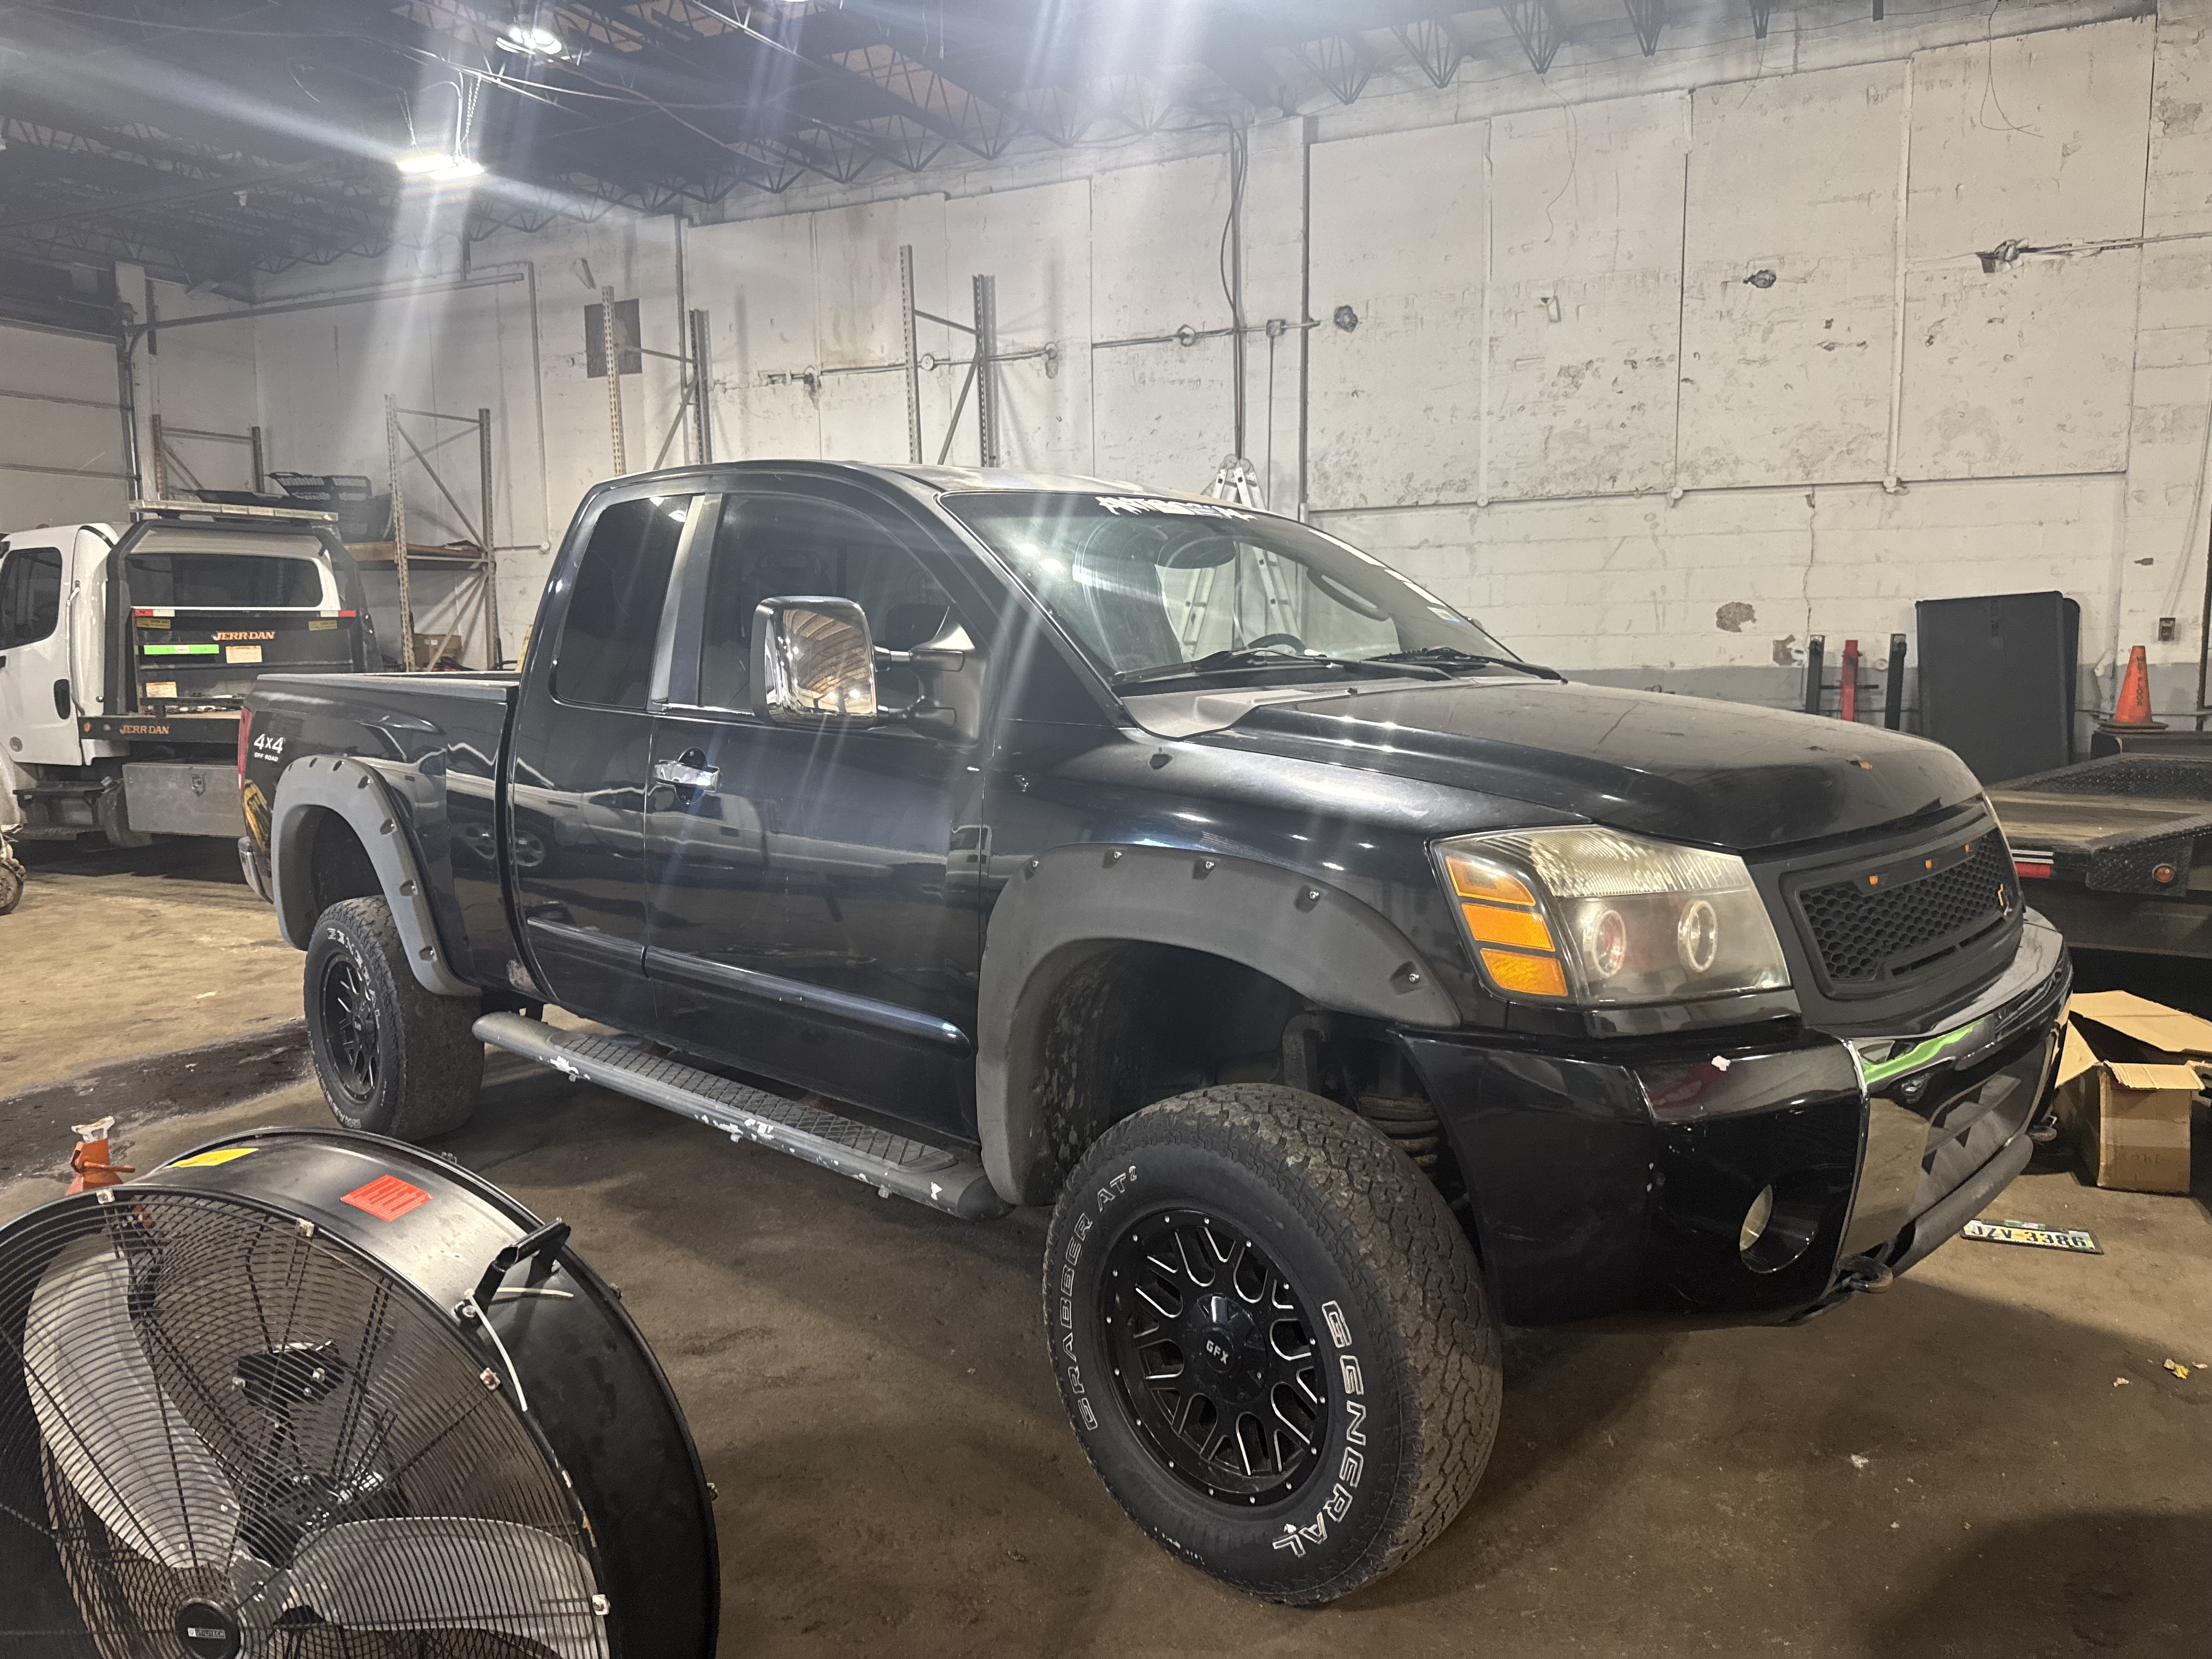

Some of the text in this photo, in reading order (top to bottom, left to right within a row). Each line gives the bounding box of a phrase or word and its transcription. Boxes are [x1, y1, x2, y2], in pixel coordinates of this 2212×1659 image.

[2024, 1231, 2086, 1247] 3386
[1060, 1212, 1098, 1430] GRABBER
[1206, 1340, 1228, 1364] GFX
[1272, 1300, 1367, 1558] GENERAL
